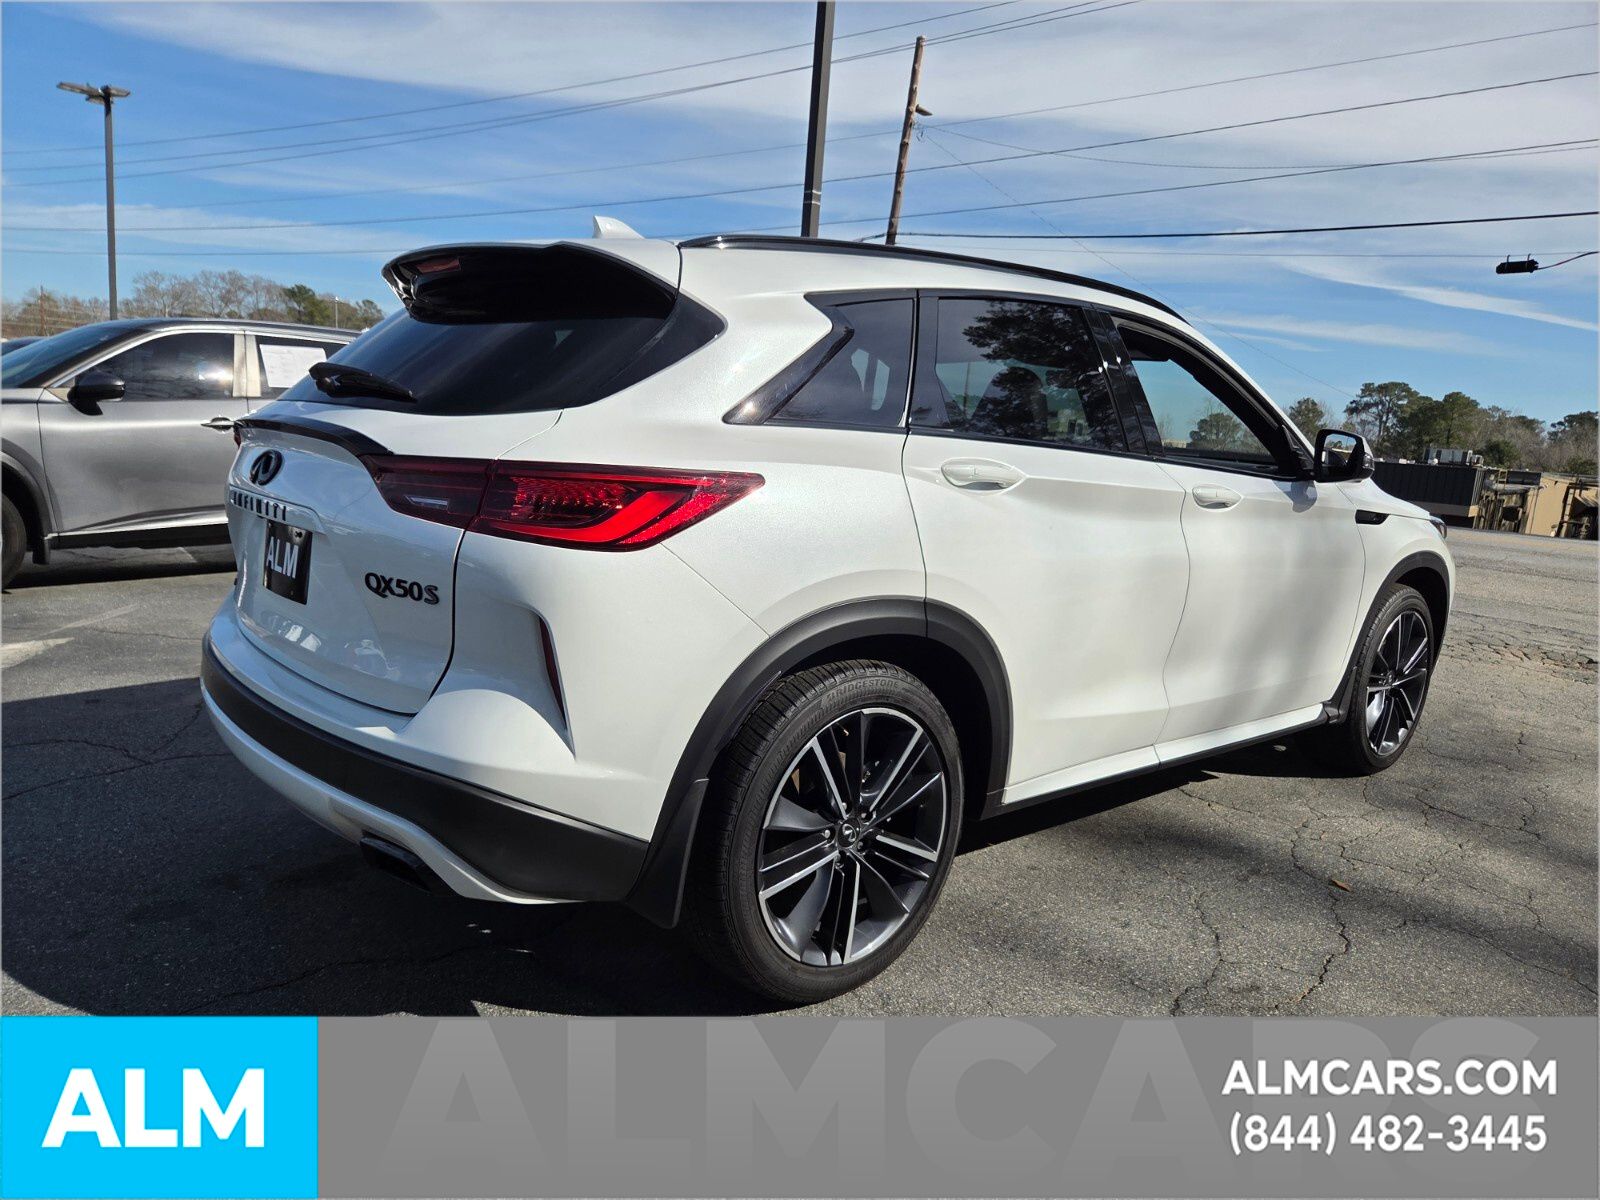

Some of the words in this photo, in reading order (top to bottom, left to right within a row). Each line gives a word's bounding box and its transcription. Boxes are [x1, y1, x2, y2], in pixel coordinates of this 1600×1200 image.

[232, 490, 287, 522] INFINITI
[266, 536, 299, 579] ALM
[825, 680, 899, 701] BRIDGESTONE
